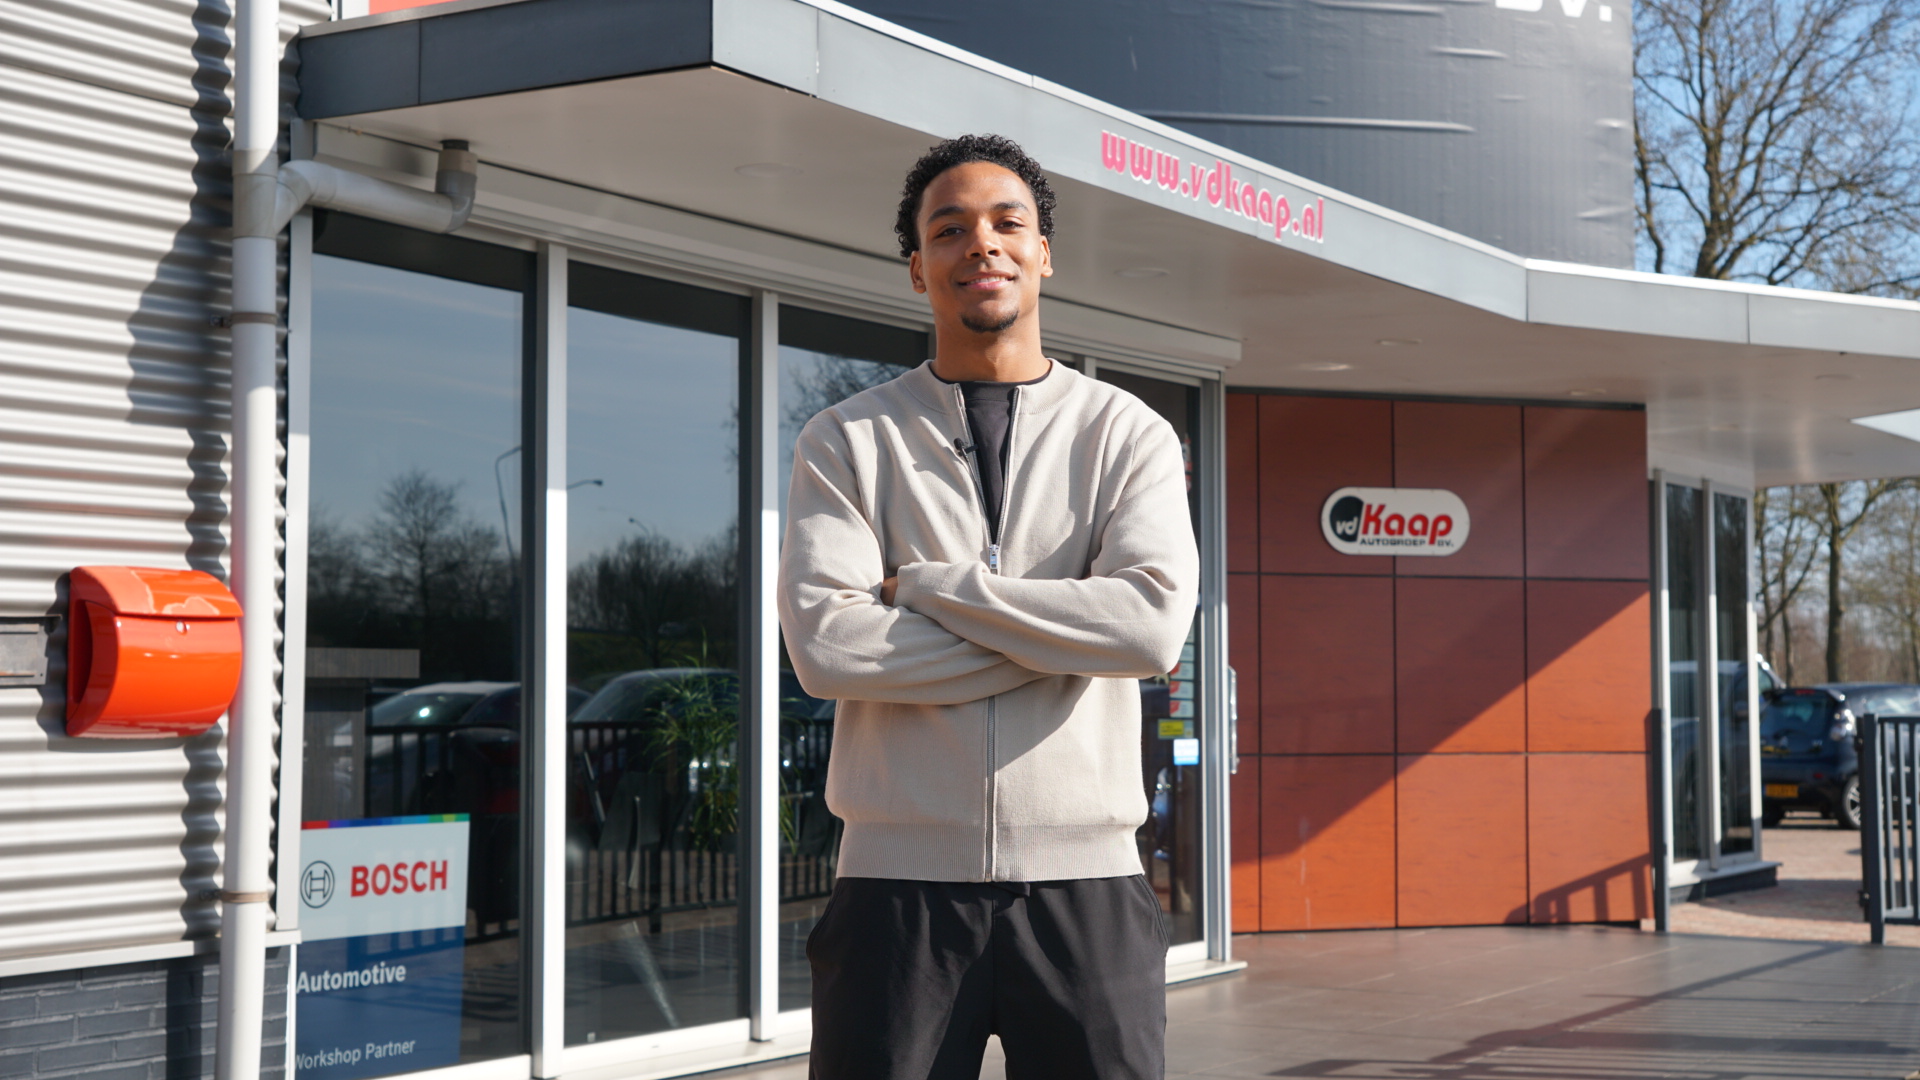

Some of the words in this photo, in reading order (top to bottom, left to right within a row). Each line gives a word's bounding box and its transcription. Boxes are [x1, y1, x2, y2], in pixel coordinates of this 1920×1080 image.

[1101, 129, 1324, 243] www.vdkaap.nl
[1362, 503, 1453, 545] Kaap
[1359, 538, 1425, 547] AUTOGROEP
[351, 860, 448, 898] BOSCH
[296, 961, 406, 994] Automotive
[366, 1040, 416, 1060] Partner
